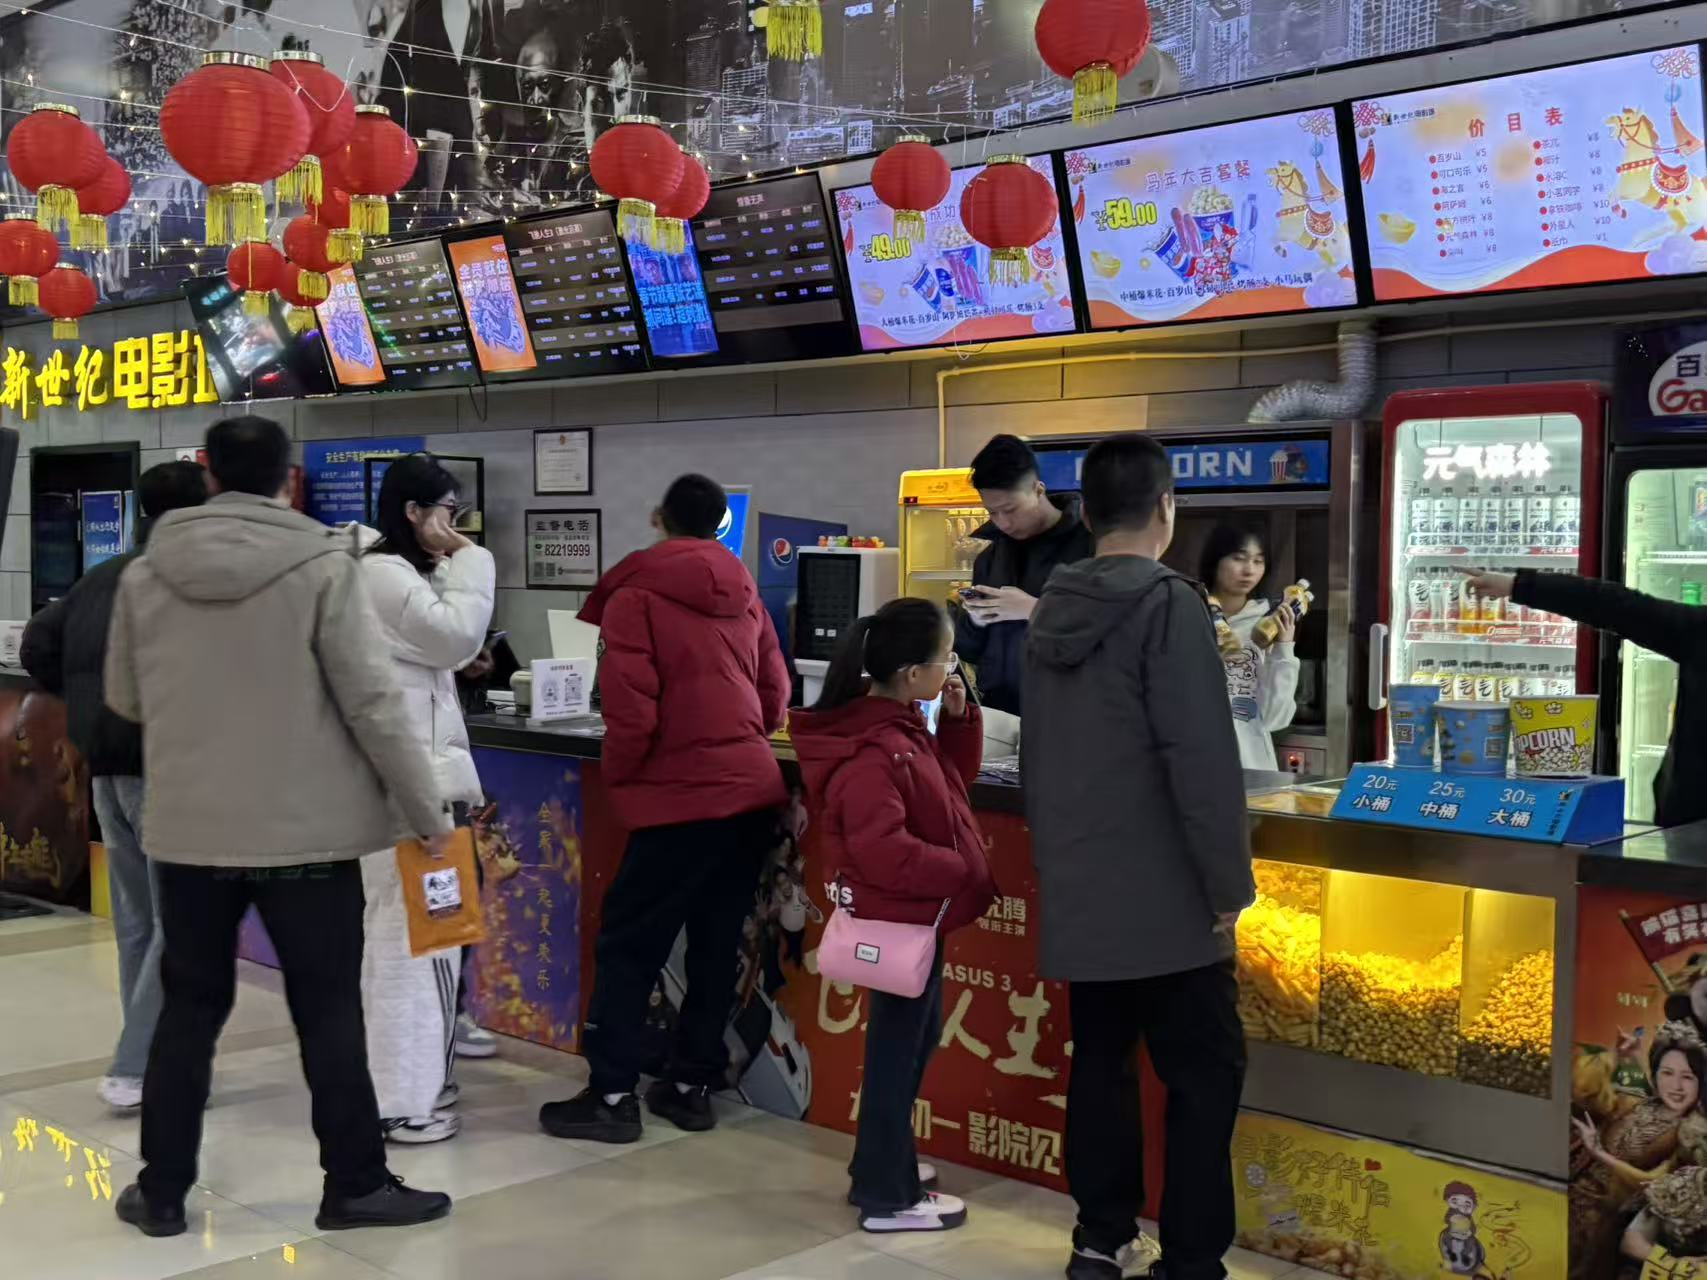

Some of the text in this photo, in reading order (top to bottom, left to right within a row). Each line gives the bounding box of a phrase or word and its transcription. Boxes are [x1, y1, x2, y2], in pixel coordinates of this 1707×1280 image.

[1468, 106, 1563, 138] 价目表
[1437, 148, 1487, 163] 百岁山 ¥5
[1145, 159, 1251, 193] 马年大吉套餐
[1439, 166, 1472, 179] 可口可乐
[1593, 199, 1610, 209] ¥10
[1091, 197, 1158, 231] ¥59.00
[1549, 215, 1611, 232] 外星人 ¥10
[1676, 354, 1707, 377] 百
[1421, 441, 1553, 482] 元气森林
[544, 543, 591, 557] 82219999
[1514, 727, 1576, 752] OPCORN
[1362, 774, 1399, 791] 20元
[1429, 780, 1465, 799] 25元
[1353, 795, 1392, 812] 小桶
[1500, 788, 1536, 806] 30元
[1419, 802, 1460, 820] 中桶
[1487, 809, 1533, 828] 大桶
[942, 961, 1012, 992] ASUS 3
[967, 1109, 1062, 1176] 影院见
